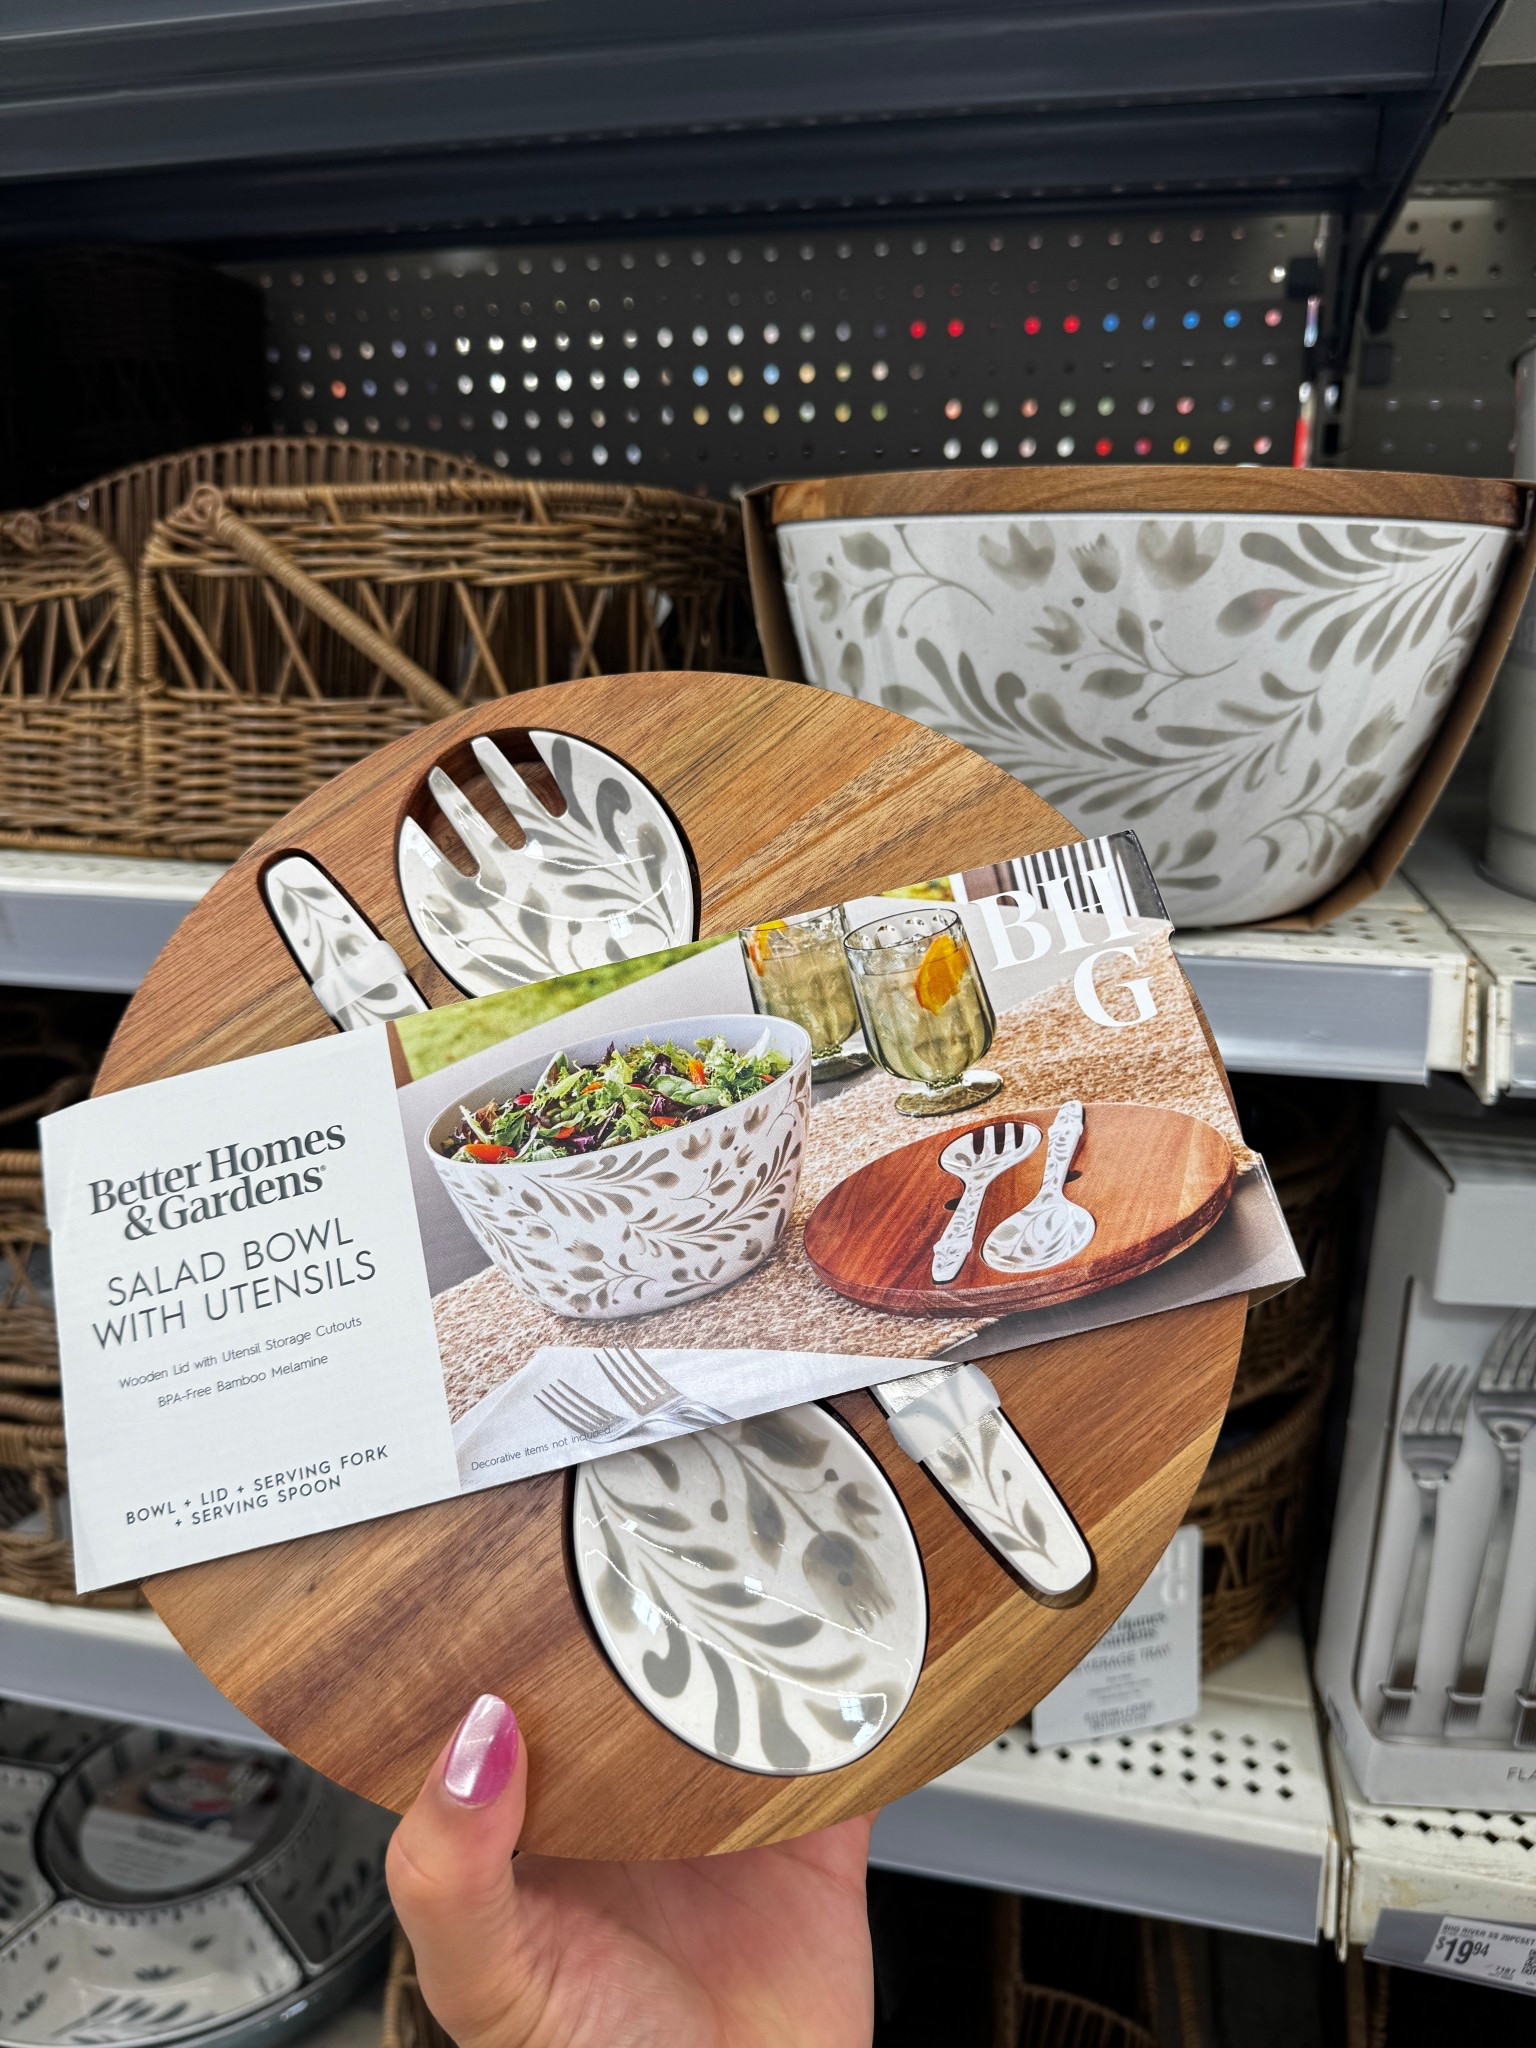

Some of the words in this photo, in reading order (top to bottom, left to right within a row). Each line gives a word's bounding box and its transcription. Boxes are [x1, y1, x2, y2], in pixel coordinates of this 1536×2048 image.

[970, 865, 1140, 971] BH
[1073, 946, 1160, 1028] G
[89, 1161, 202, 1215] Better
[206, 1124, 346, 1182] Homes
[92, 1300, 187, 1350] WITH
[204, 1250, 376, 1321] UTENSILS
[108, 1251, 226, 1306] SALAD
[243, 1217, 354, 1270] BOWL
[119, 1368, 168, 1389] Wooden
[173, 1361, 190, 1376] Lid
[194, 1354, 217, 1369] with
[222, 1343, 261, 1362] Utensil
[265, 1331, 312, 1351] Storage
[315, 1316, 362, 1337] Cutouts
[158, 1384, 212, 1407] BPA-Free
[216, 1371, 267, 1392] Bamboo
[271, 1354, 328, 1378] Melamine
[126, 1501, 176, 1525] BOWL
[201, 1487, 228, 1505] LID
[254, 1460, 331, 1492] SERVING
[340, 1444, 388, 1469] FORK
[471, 1450, 522, 1471] Decorative
[524, 1444, 549, 1456] items
[552, 1438, 568, 1449] not
[192, 1494, 269, 1525] SERVING
[278, 1475, 341, 1502] SPOON
[1462, 1927, 1486, 1938] RIVER
